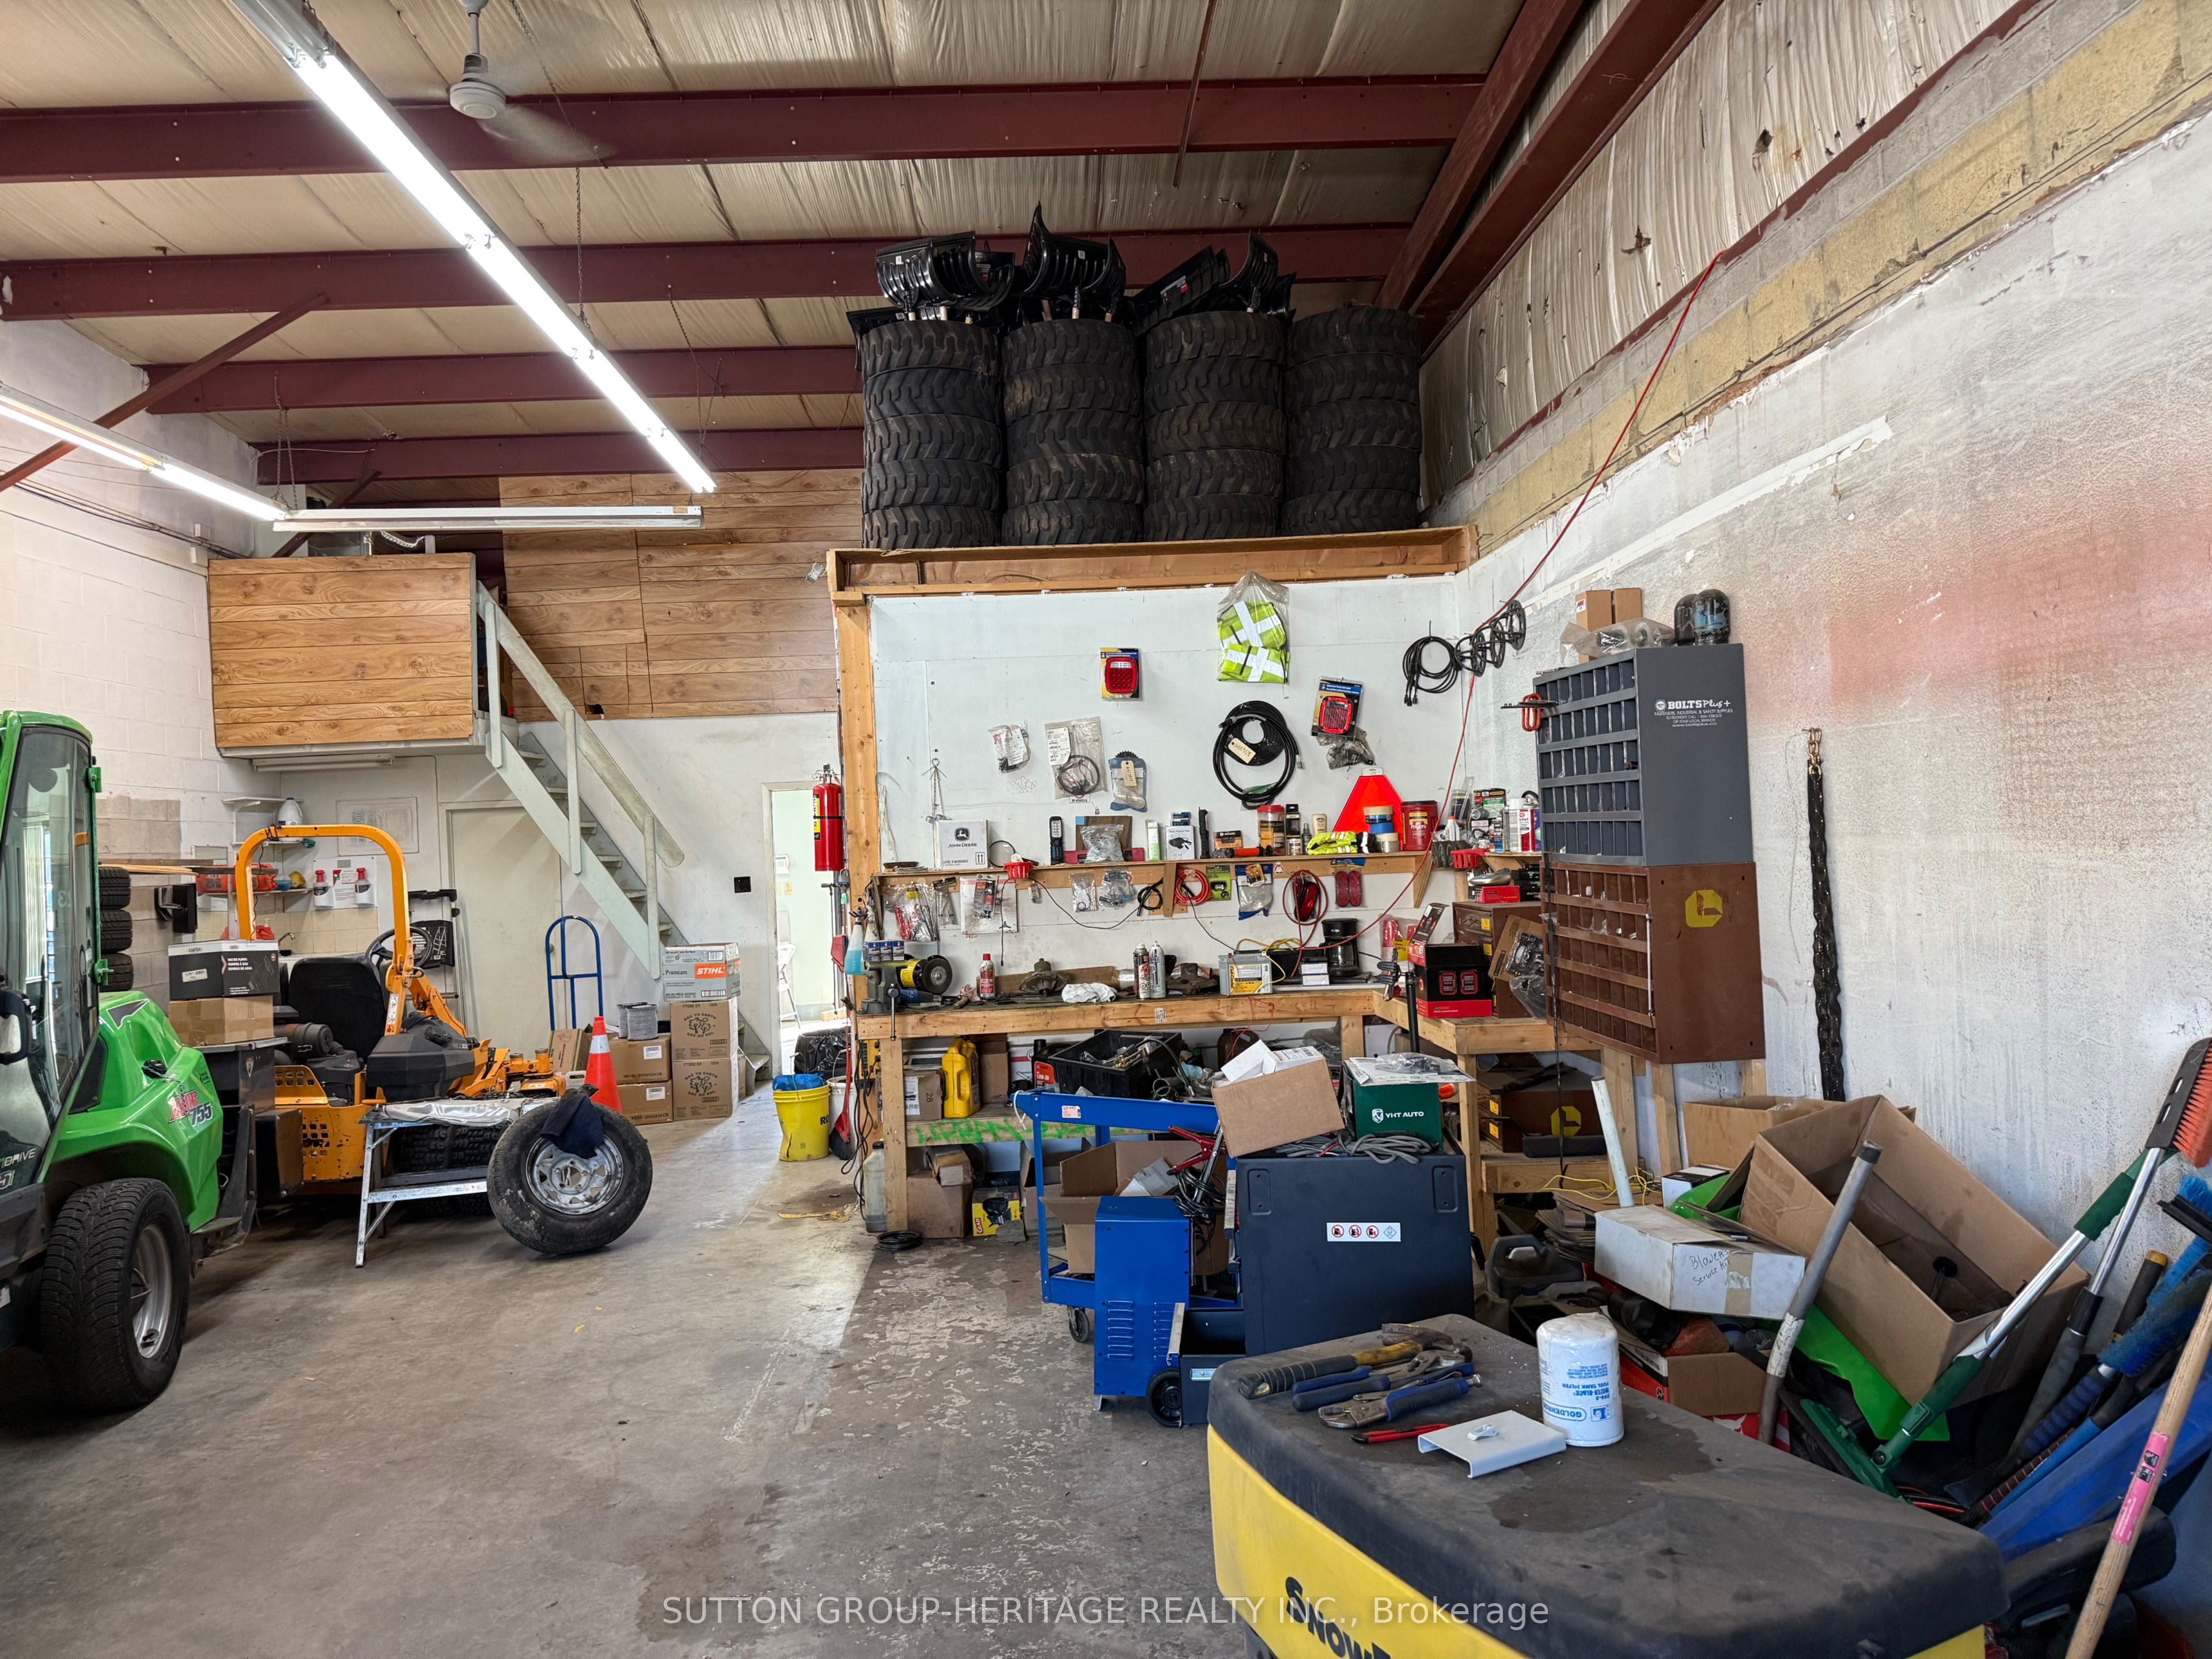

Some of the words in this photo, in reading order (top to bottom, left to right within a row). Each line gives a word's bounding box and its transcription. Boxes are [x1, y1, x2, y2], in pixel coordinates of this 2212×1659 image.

[1668, 699, 1702, 709] BOLTS
[926, 1092, 934, 1103] 28
[187, 1101, 213, 1127] 755
